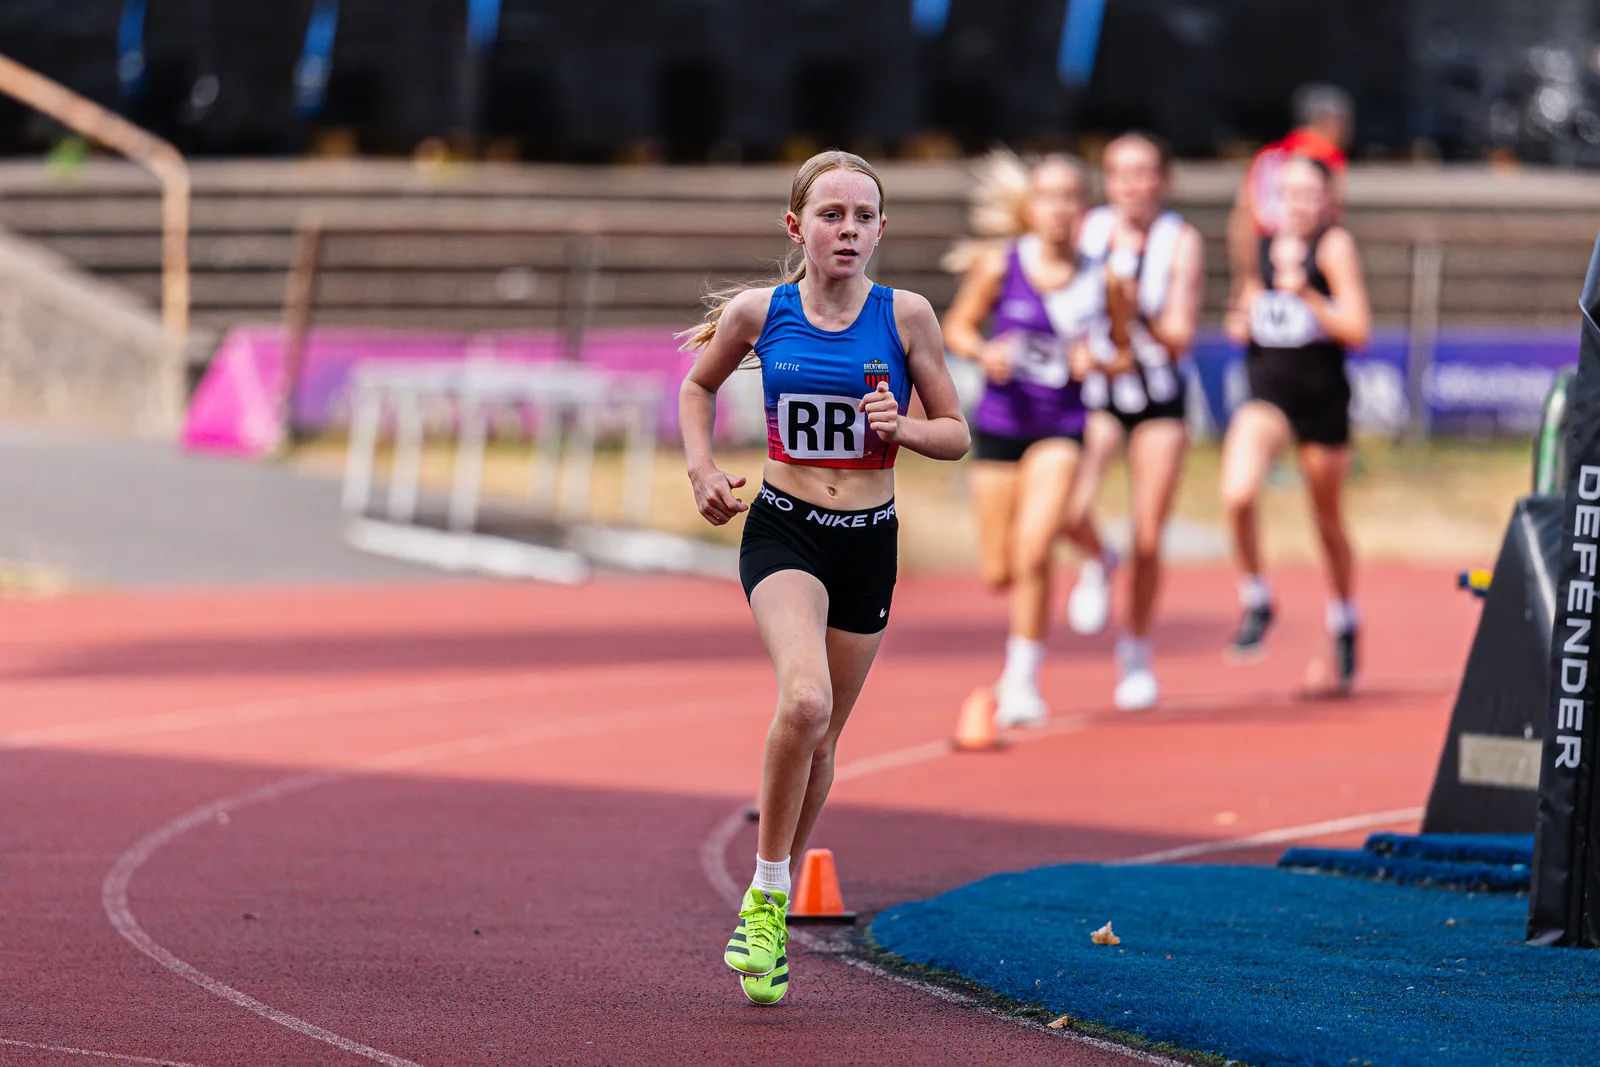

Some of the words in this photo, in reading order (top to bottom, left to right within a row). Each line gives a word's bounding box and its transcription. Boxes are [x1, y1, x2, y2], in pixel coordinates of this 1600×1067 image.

[775, 362, 800, 371] TACTIC
[788, 400, 856, 451] RR
[806, 510, 868, 527] NIKE
[1555, 464, 1600, 769] DEFENDER
